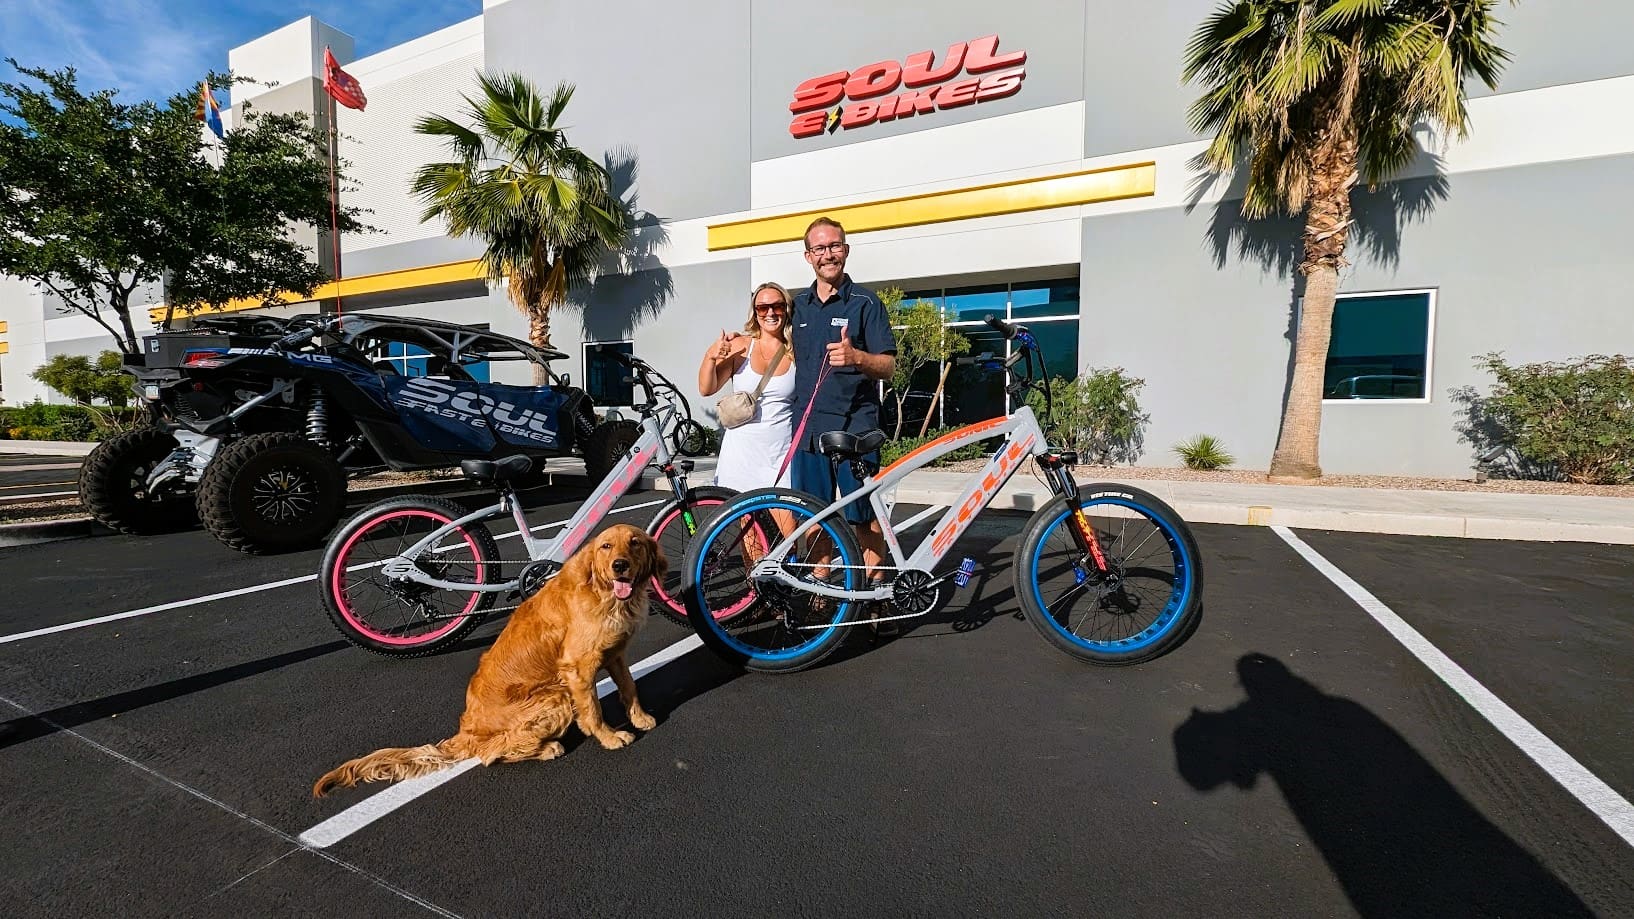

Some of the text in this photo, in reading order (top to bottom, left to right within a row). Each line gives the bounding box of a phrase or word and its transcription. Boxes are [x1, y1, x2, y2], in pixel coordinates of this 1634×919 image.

[789, 34, 1027, 115] SOUL
[789, 67, 1027, 140] E BIKES
[394, 397, 473, 422] FAST
[499, 424, 555, 444] BIKES
[398, 376, 557, 436] SOUL
[931, 433, 1035, 558] SOUL
